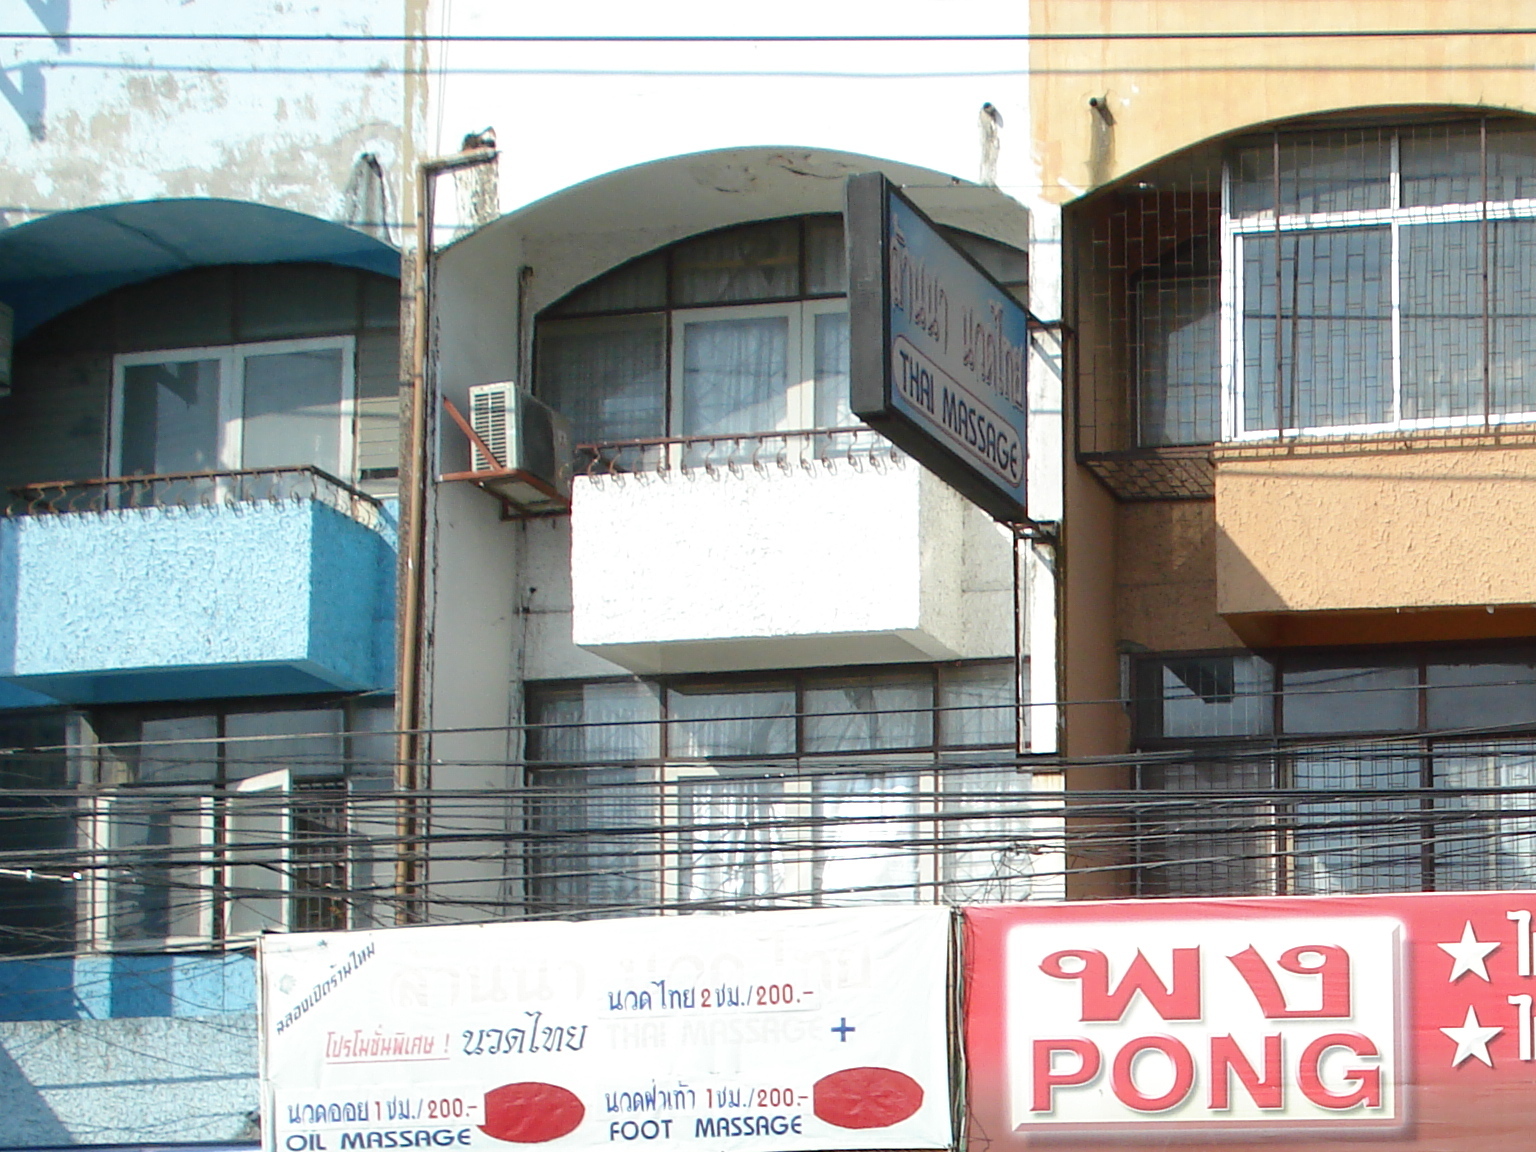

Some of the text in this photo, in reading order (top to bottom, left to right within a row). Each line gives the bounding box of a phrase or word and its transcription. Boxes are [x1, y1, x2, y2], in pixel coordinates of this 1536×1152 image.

[900, 350, 1019, 479] THAI MASSAGE
[1038, 944, 1352, 1021] พง
[461, 1010, 588, 1056] นวดไทย
[1031, 1031, 1382, 1112] PONG
[286, 1128, 471, 1151] OIL MASSAGE
[610, 1115, 803, 1141] FOOT MASSAGE
